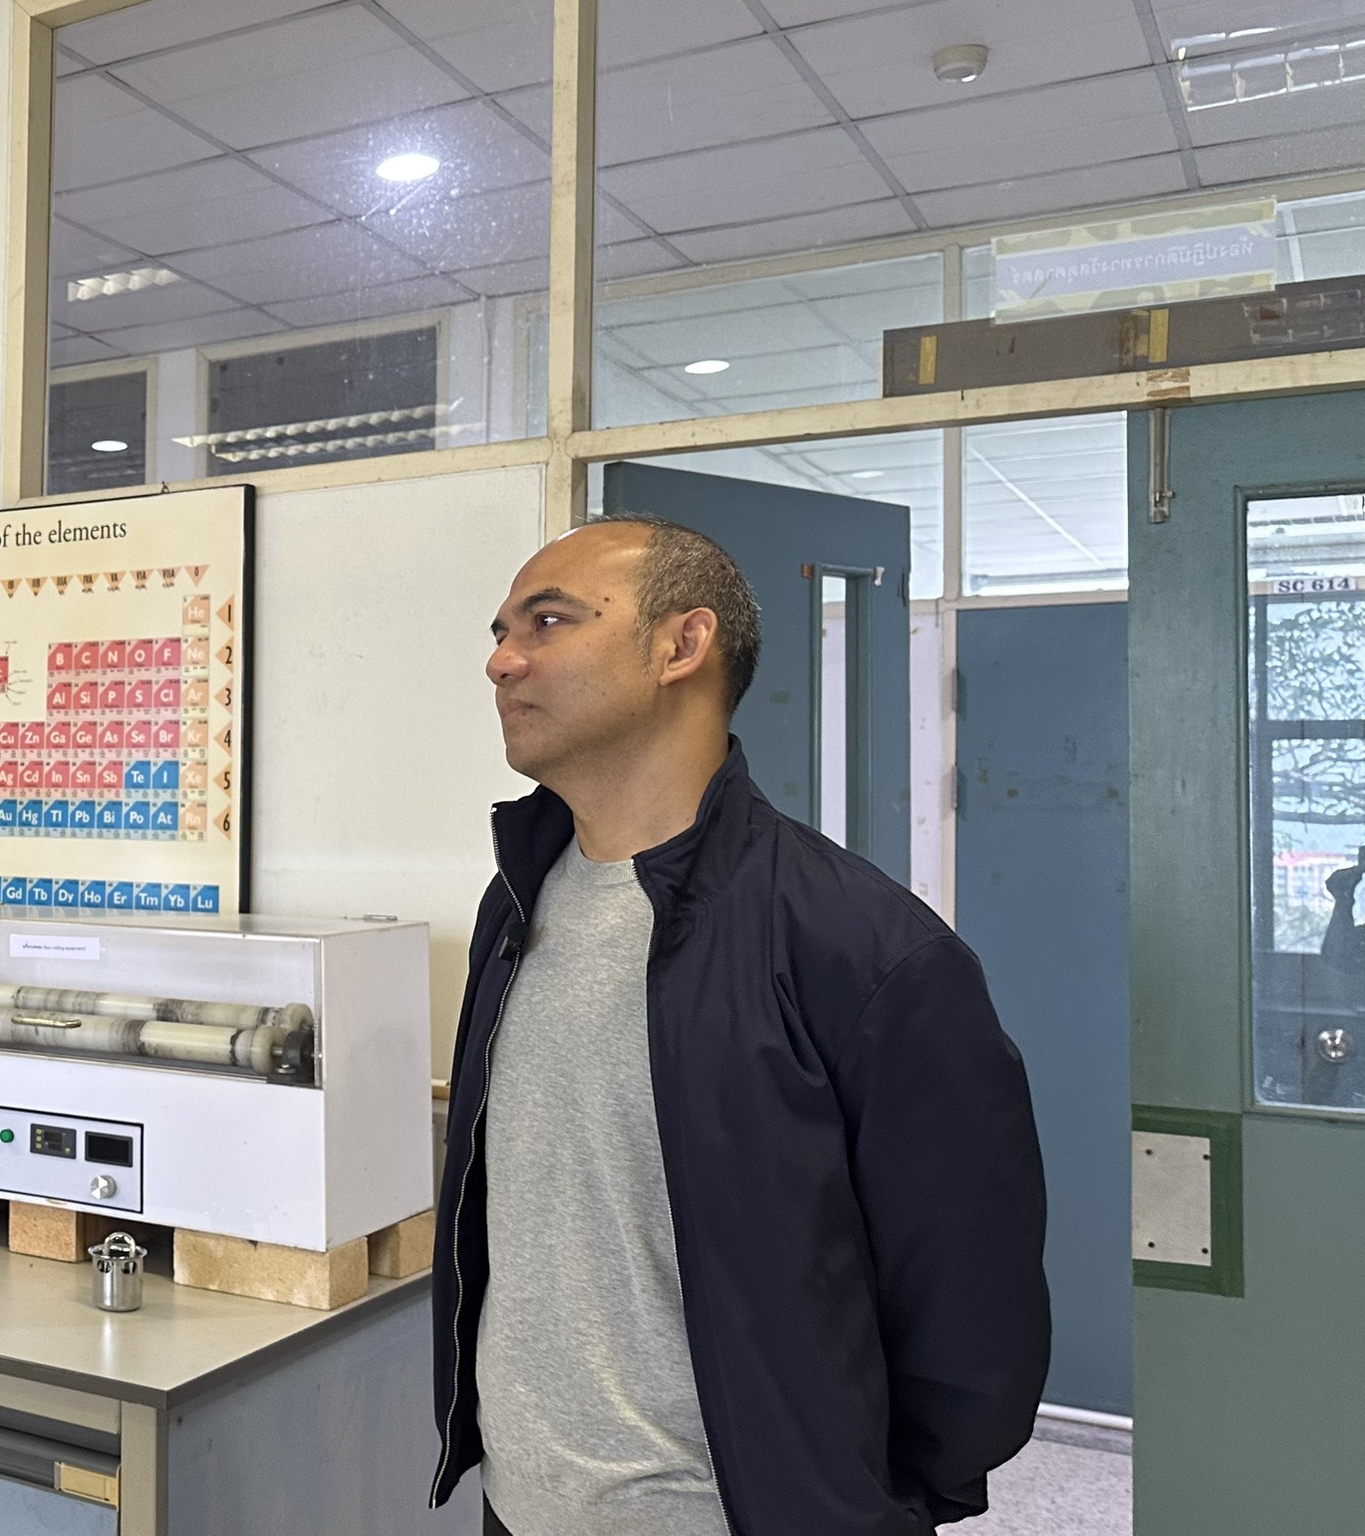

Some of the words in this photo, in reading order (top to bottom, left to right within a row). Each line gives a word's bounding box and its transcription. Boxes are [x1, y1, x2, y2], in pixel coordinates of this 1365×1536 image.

[15, 523, 42, 547] the
[48, 519, 127, 544] elements
[1278, 580, 1305, 593] SC
[1311, 577, 1351, 591] 614
[187, 606, 205, 619] He
[81, 651, 91, 665] C
[107, 650, 118, 663] N
[134, 649, 146, 663] O
[186, 647, 204, 661] Ne
[225, 645, 233, 665] 2
[52, 692, 66, 705] Al
[80, 691, 91, 704] Si
[160, 689, 174, 703] Cl
[186, 688, 203, 701] Ar
[224, 687, 232, 707] 3
[0, 731, 15, 744] Cu
[24, 731, 40, 744] Zn
[49, 731, 66, 744] Ga
[76, 730, 93, 744] Ge
[103, 730, 119, 743] As
[131, 730, 146, 743] Se
[159, 729, 174, 743] Br
[186, 729, 202, 743] Kr
[223, 729, 232, 748] 4
[23, 770, 39, 783] Cd
[51, 770, 63, 783] In
[76, 770, 91, 783] Sn
[102, 770, 118, 783] Sb
[130, 770, 145, 784] Te
[185, 771, 201, 784] Xe
[223, 771, 231, 790] 5
[22, 809, 38, 825] Hg
[75, 810, 90, 823] Pb
[103, 810, 115, 823] Bi
[129, 811, 144, 824] Po
[157, 811, 172, 825] At
[185, 812, 201, 825] Rn
[222, 813, 231, 832] 6
[6, 886, 23, 900] Gd
[32, 887, 48, 901] Tb
[58, 889, 74, 903] Dy
[84, 890, 102, 903] Ho
[113, 891, 127, 904] Er
[138, 892, 159, 906] Tm
[168, 894, 185, 908] Yb
[197, 895, 213, 909] Lu
